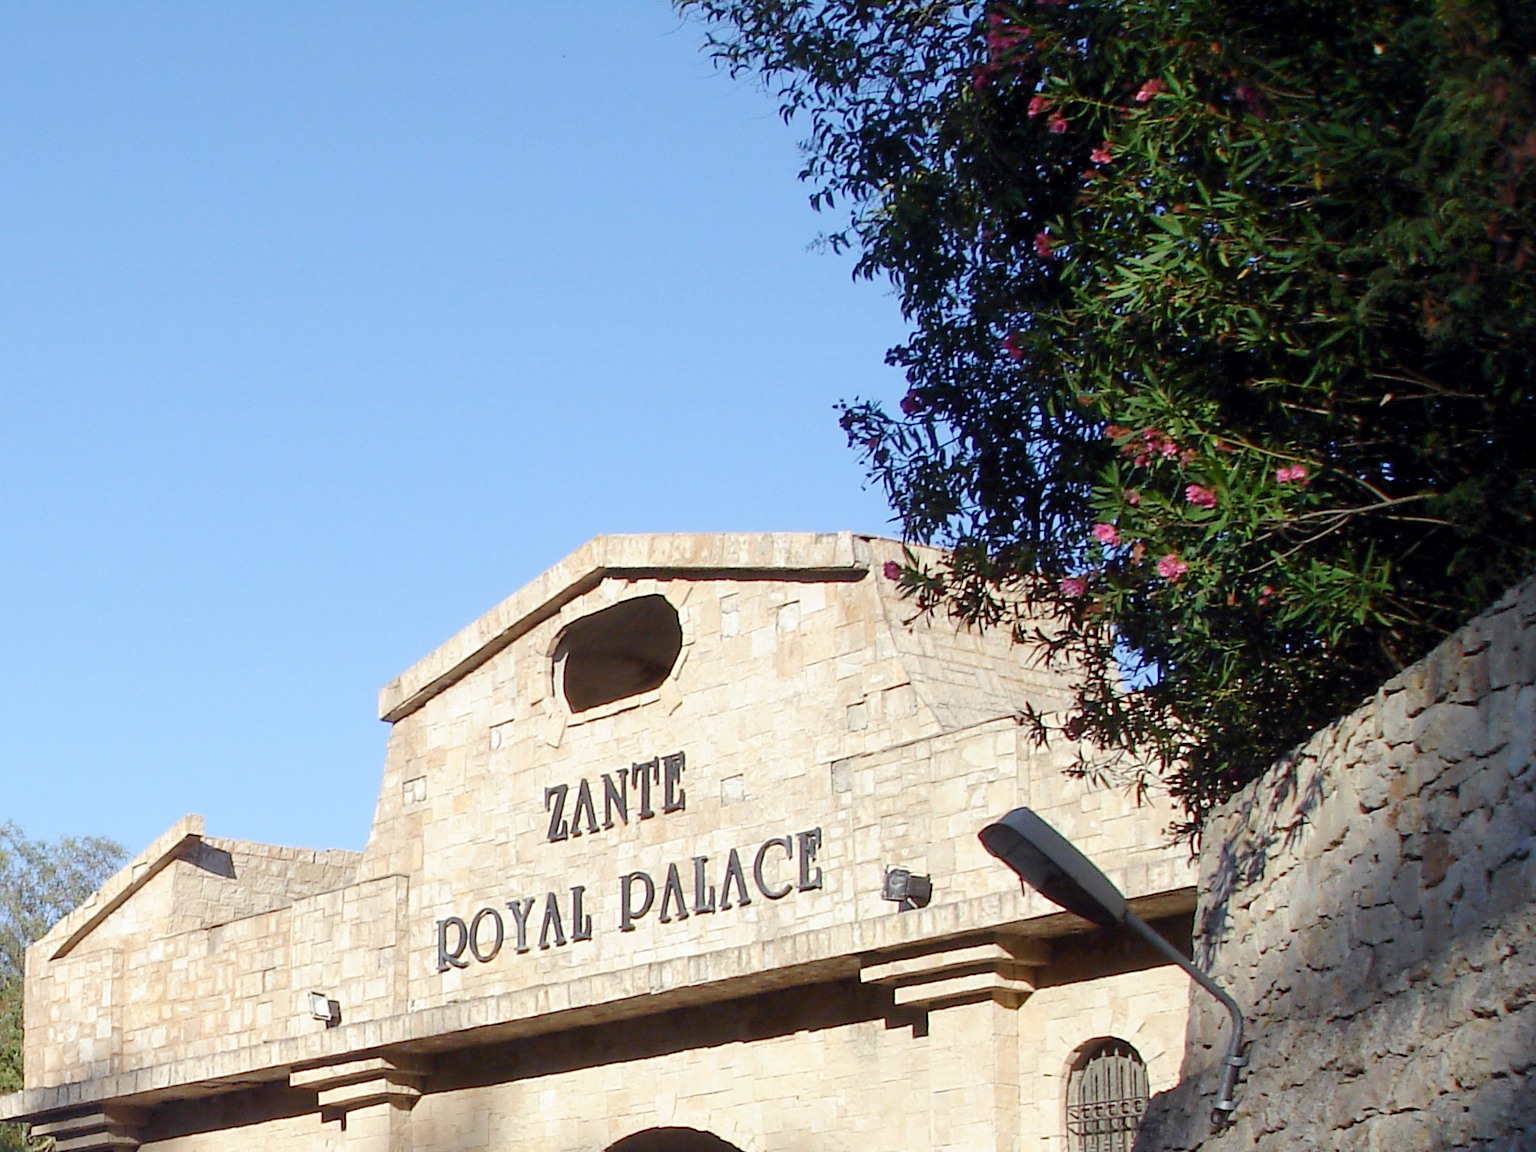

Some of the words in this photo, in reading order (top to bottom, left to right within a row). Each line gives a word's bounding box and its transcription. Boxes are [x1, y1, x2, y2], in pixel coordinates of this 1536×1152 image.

[545, 751, 686, 842] ZANTE
[437, 886, 592, 972] ROYAL
[619, 827, 822, 931] PALACE
